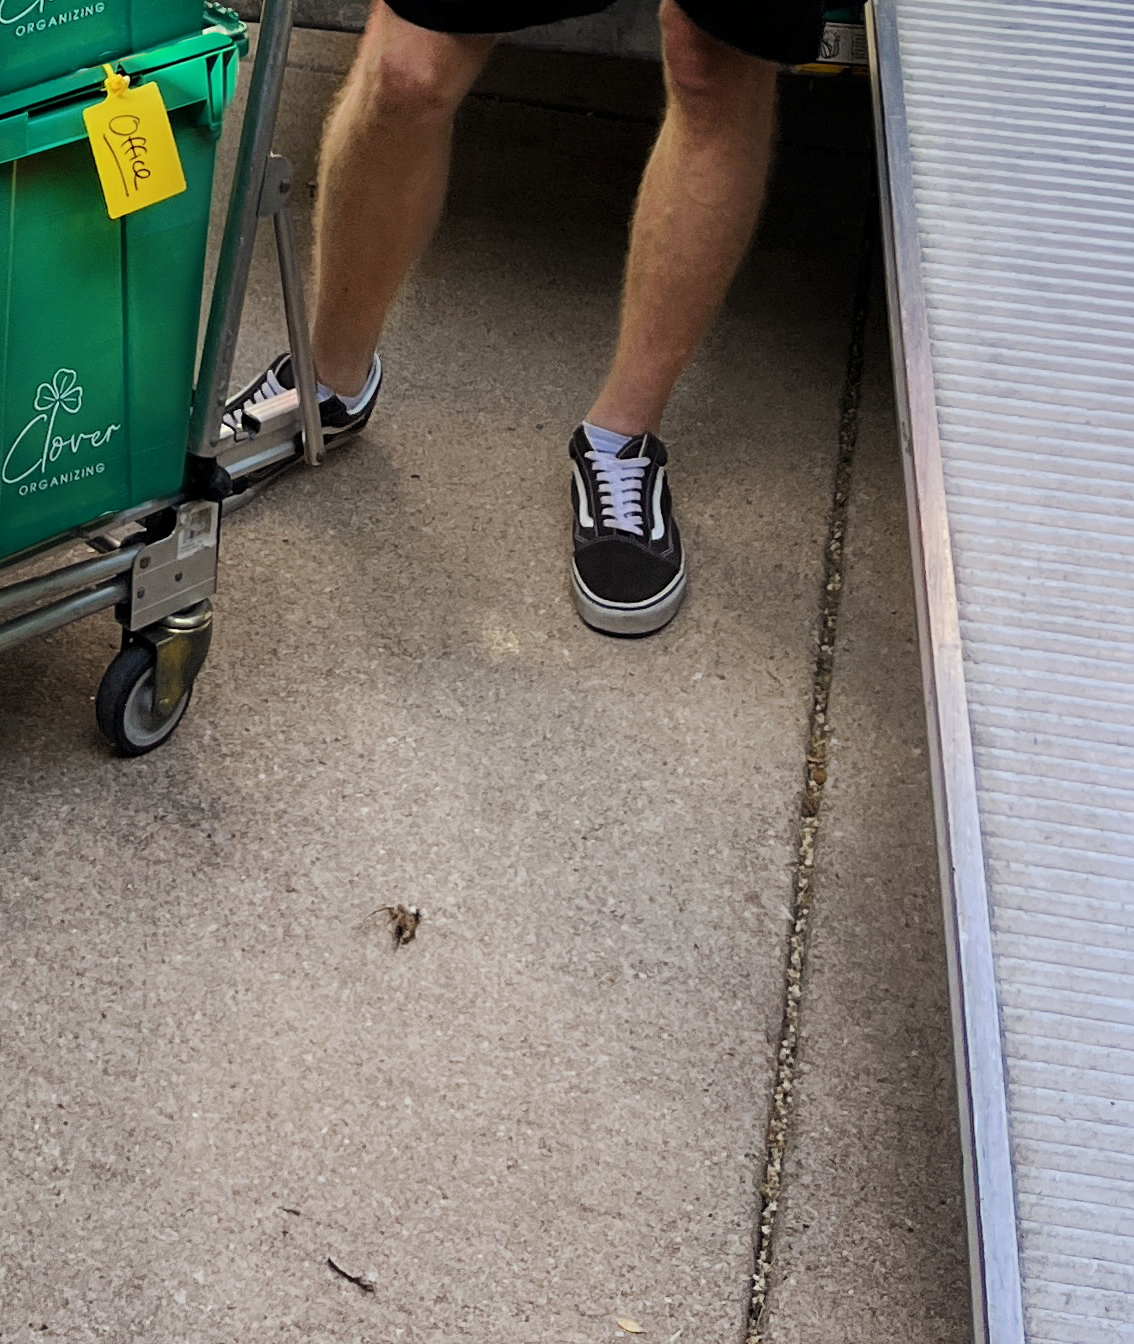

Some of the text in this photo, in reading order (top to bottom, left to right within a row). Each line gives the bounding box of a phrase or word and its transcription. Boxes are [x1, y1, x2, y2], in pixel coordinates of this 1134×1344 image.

[15, 1, 105, 37] ORGANIZING
[108, 114, 151, 191] Office
[2, 400, 122, 484] Clover
[18, 462, 106, 496] ORGANIZING
